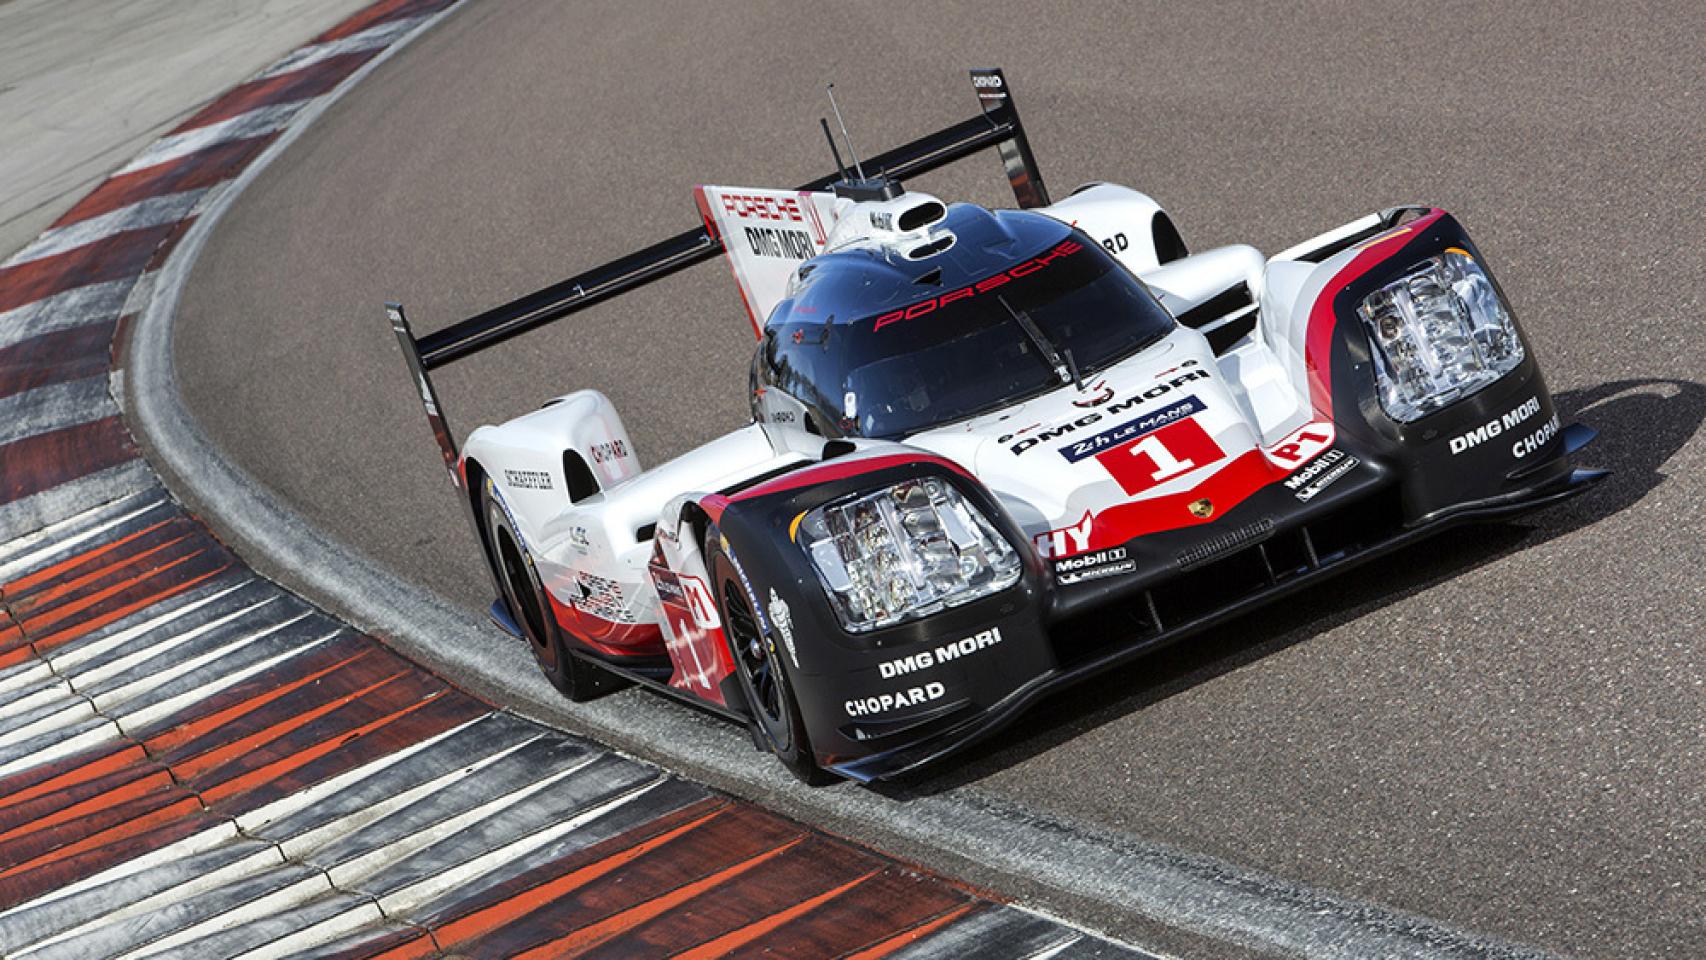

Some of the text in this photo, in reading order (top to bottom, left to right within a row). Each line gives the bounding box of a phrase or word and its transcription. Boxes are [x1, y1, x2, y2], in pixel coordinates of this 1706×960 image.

[721, 194, 802, 222] PORSCHE
[744, 226, 816, 260] DMG MORI
[873, 240, 1083, 334] PORSCHE
[1010, 369, 1211, 456] DMG MORI
[1113, 423, 1137, 439] LE
[1139, 402, 1195, 430] MANS
[1449, 396, 1541, 455] DMG MORI
[1129, 434, 1196, 482] 1
[1270, 431, 1329, 462] P1
[1284, 458, 1330, 489] Mobil
[1036, 514, 1093, 558] HY
[1056, 552, 1107, 572] Mobil
[878, 627, 1003, 679] DMG MORI
[845, 681, 946, 716] CHOPARD
